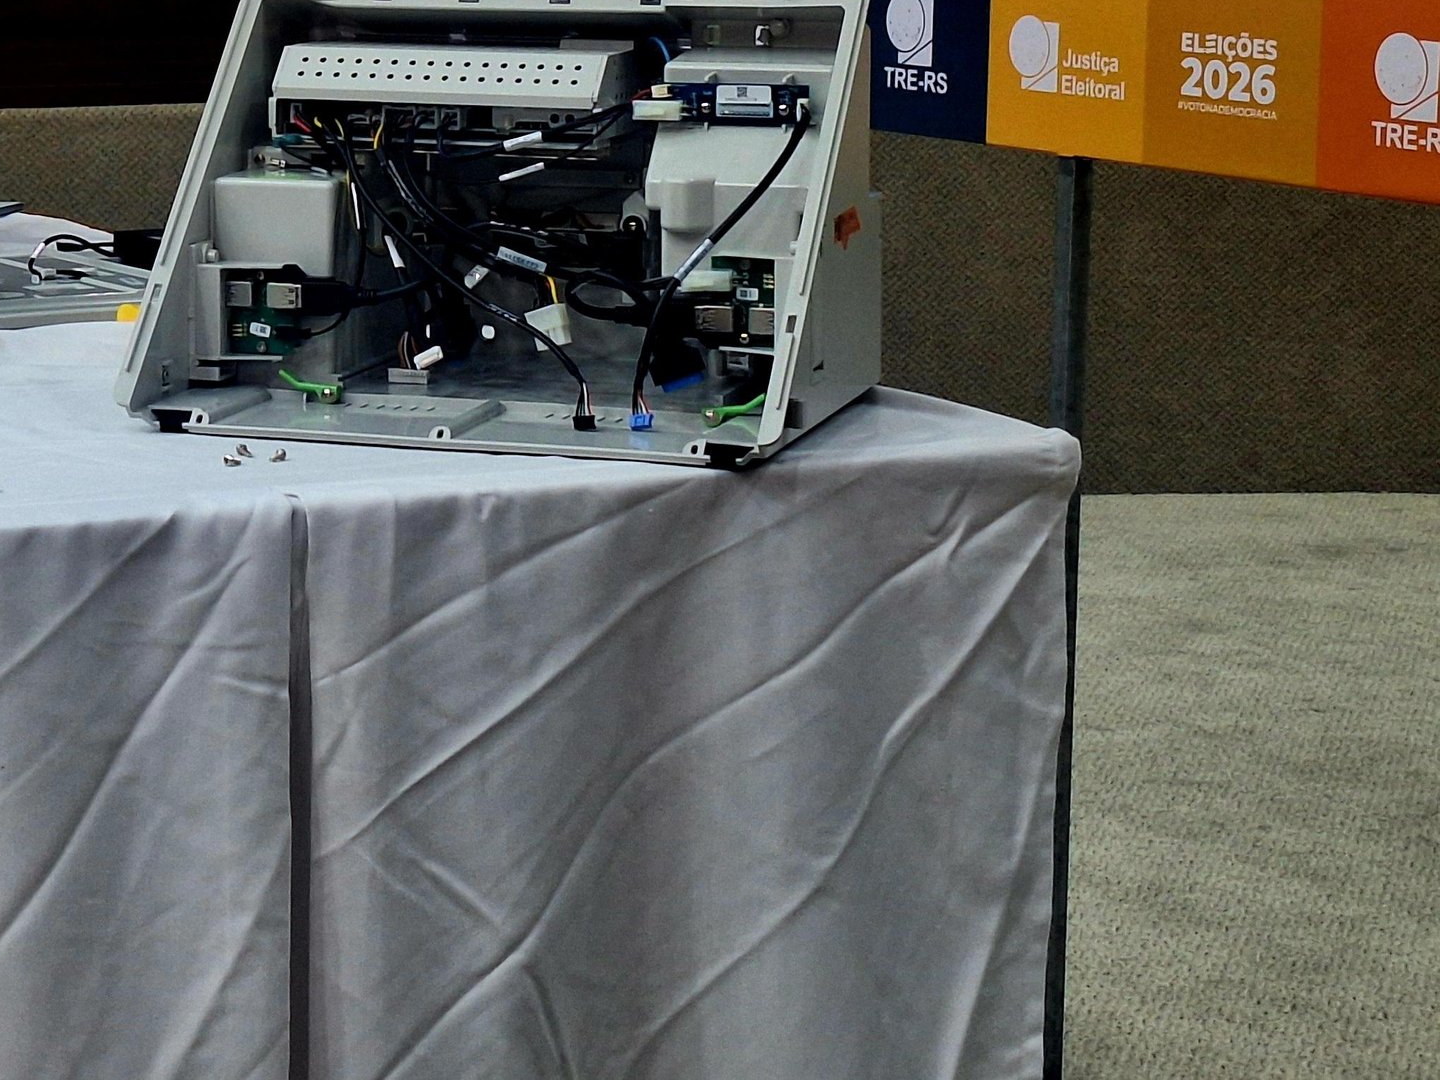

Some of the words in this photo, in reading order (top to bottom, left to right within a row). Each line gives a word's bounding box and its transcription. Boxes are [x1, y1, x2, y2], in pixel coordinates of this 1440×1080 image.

[1181, 32, 1278, 61] ELEIÇÕES
[1062, 48, 1119, 76] Justiça
[884, 66, 948, 94] TRE-RS
[1061, 75, 1125, 101] Eleitoral
[1180, 56, 1276, 105] 2026
